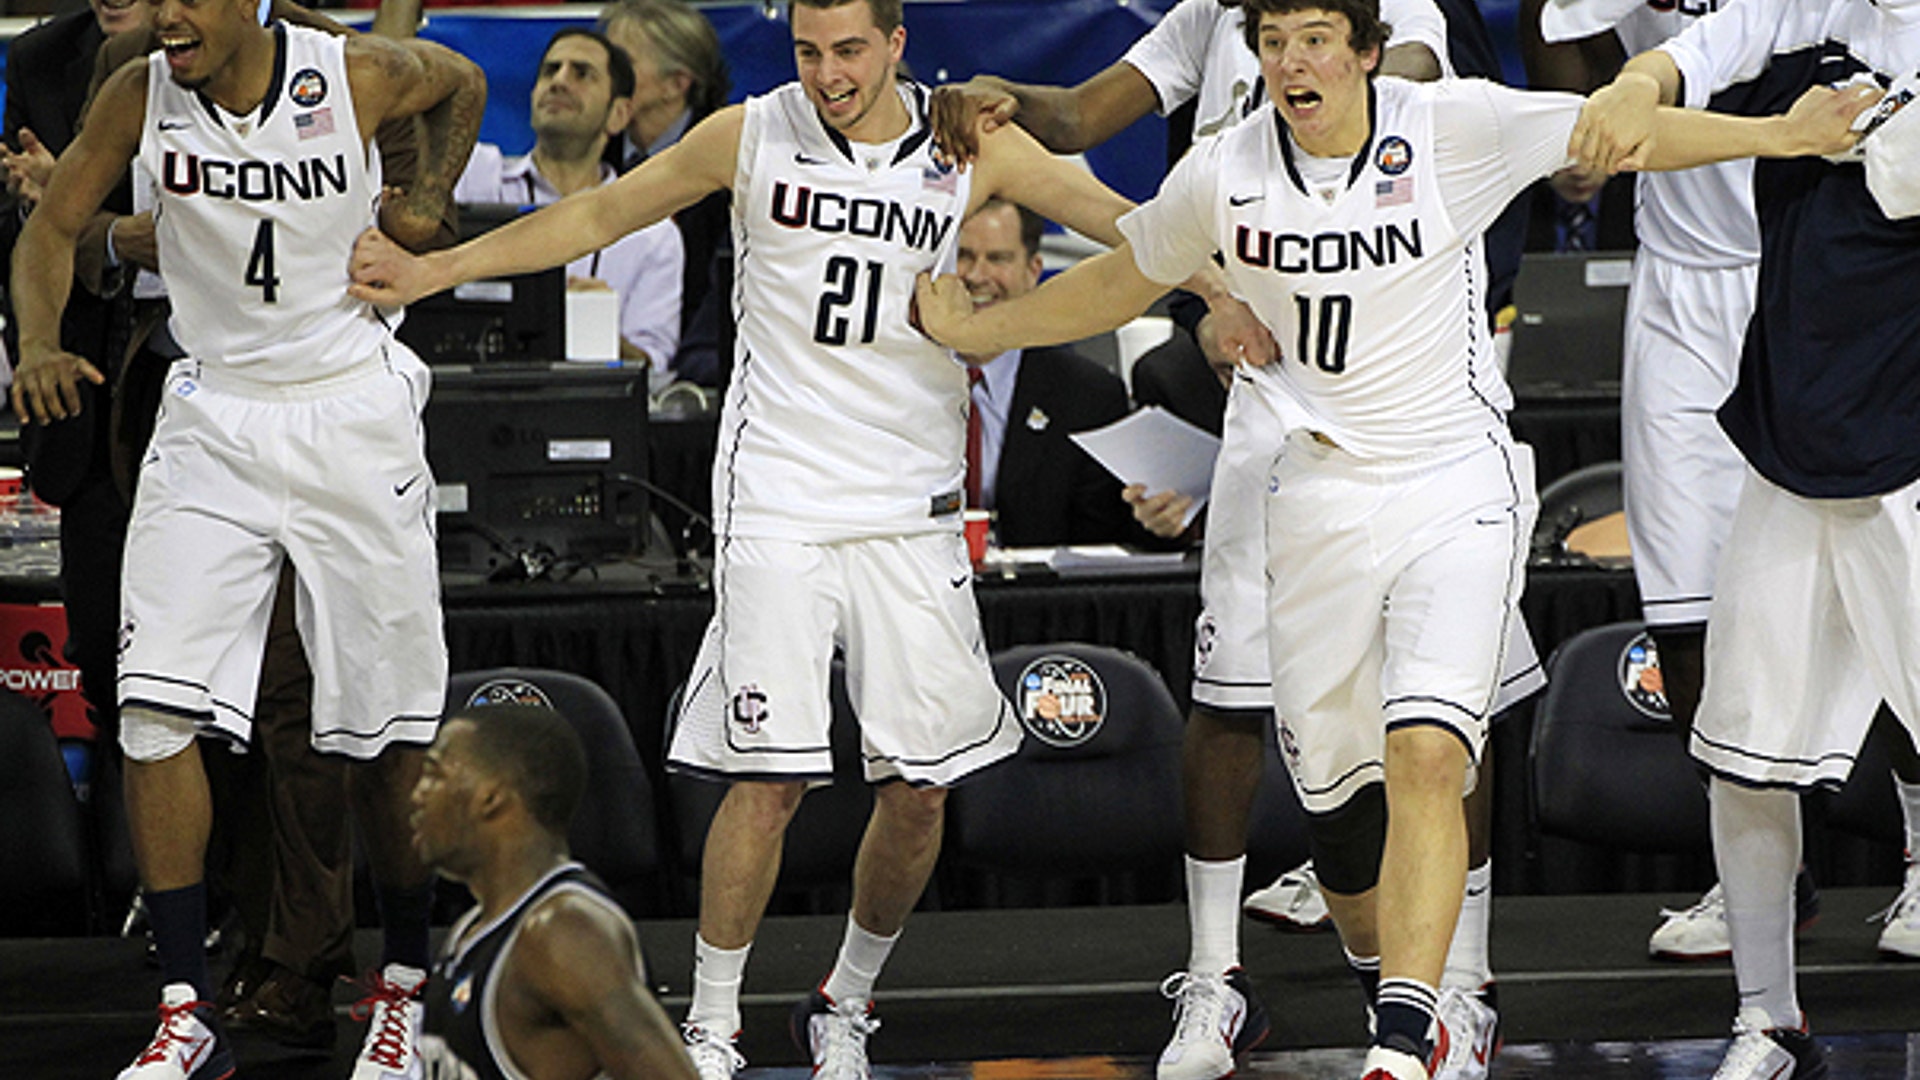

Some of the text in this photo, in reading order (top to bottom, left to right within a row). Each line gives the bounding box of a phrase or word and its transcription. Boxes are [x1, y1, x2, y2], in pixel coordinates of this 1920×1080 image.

[163, 151, 347, 201] UCONN
[770, 181, 953, 252] UCONN
[1236, 218, 1424, 274] UCONN
[244, 218, 281, 304] 4
[812, 254, 885, 347] 21
[1293, 294, 1353, 375] 10
